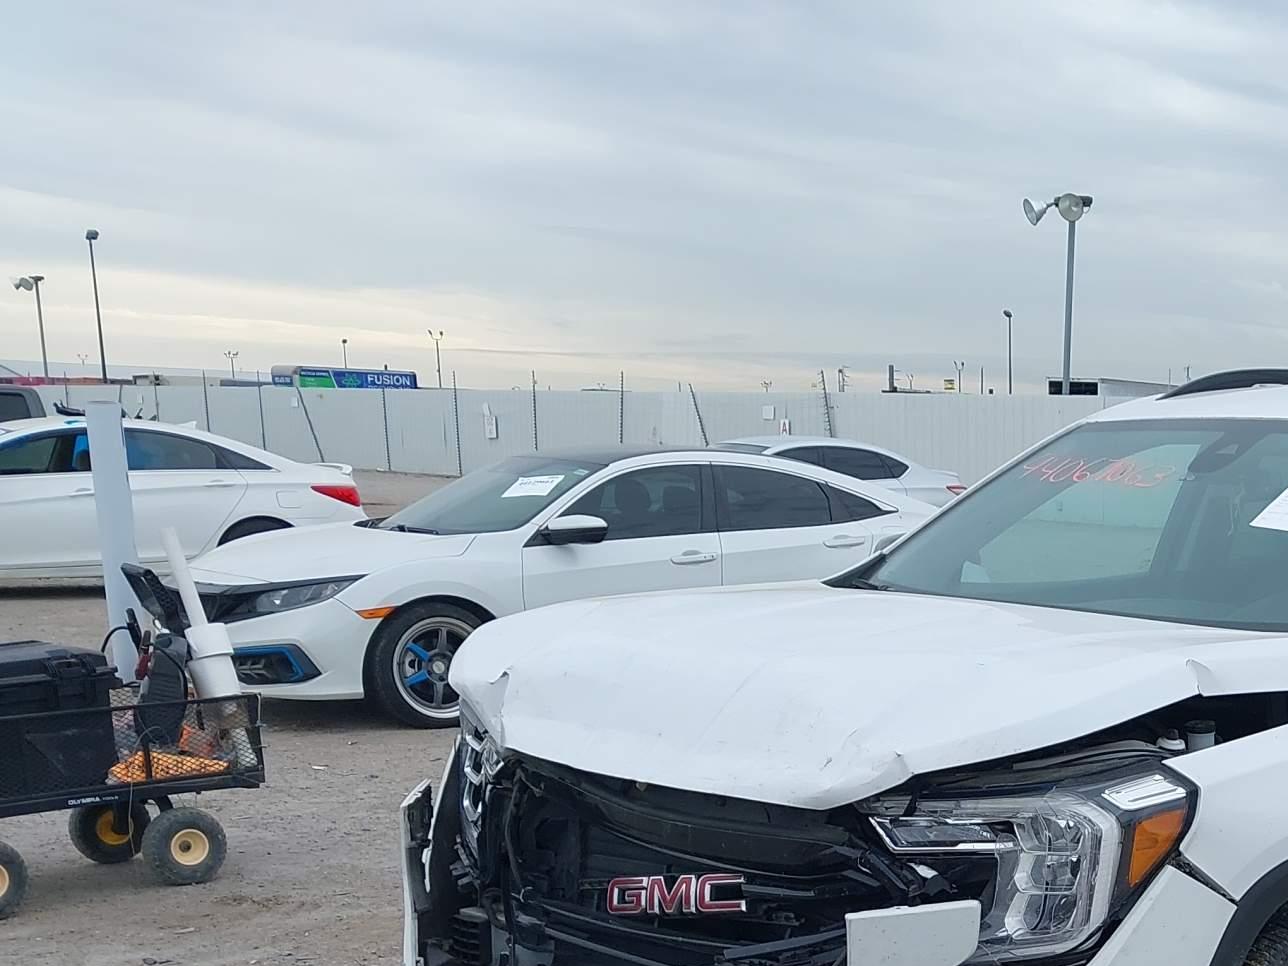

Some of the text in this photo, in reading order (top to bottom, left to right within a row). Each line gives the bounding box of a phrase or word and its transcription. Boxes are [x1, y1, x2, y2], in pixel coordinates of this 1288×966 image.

[367, 374, 410, 386] FUSION
[781, 421, 788, 434] A
[606, 873, 747, 914] GMC
